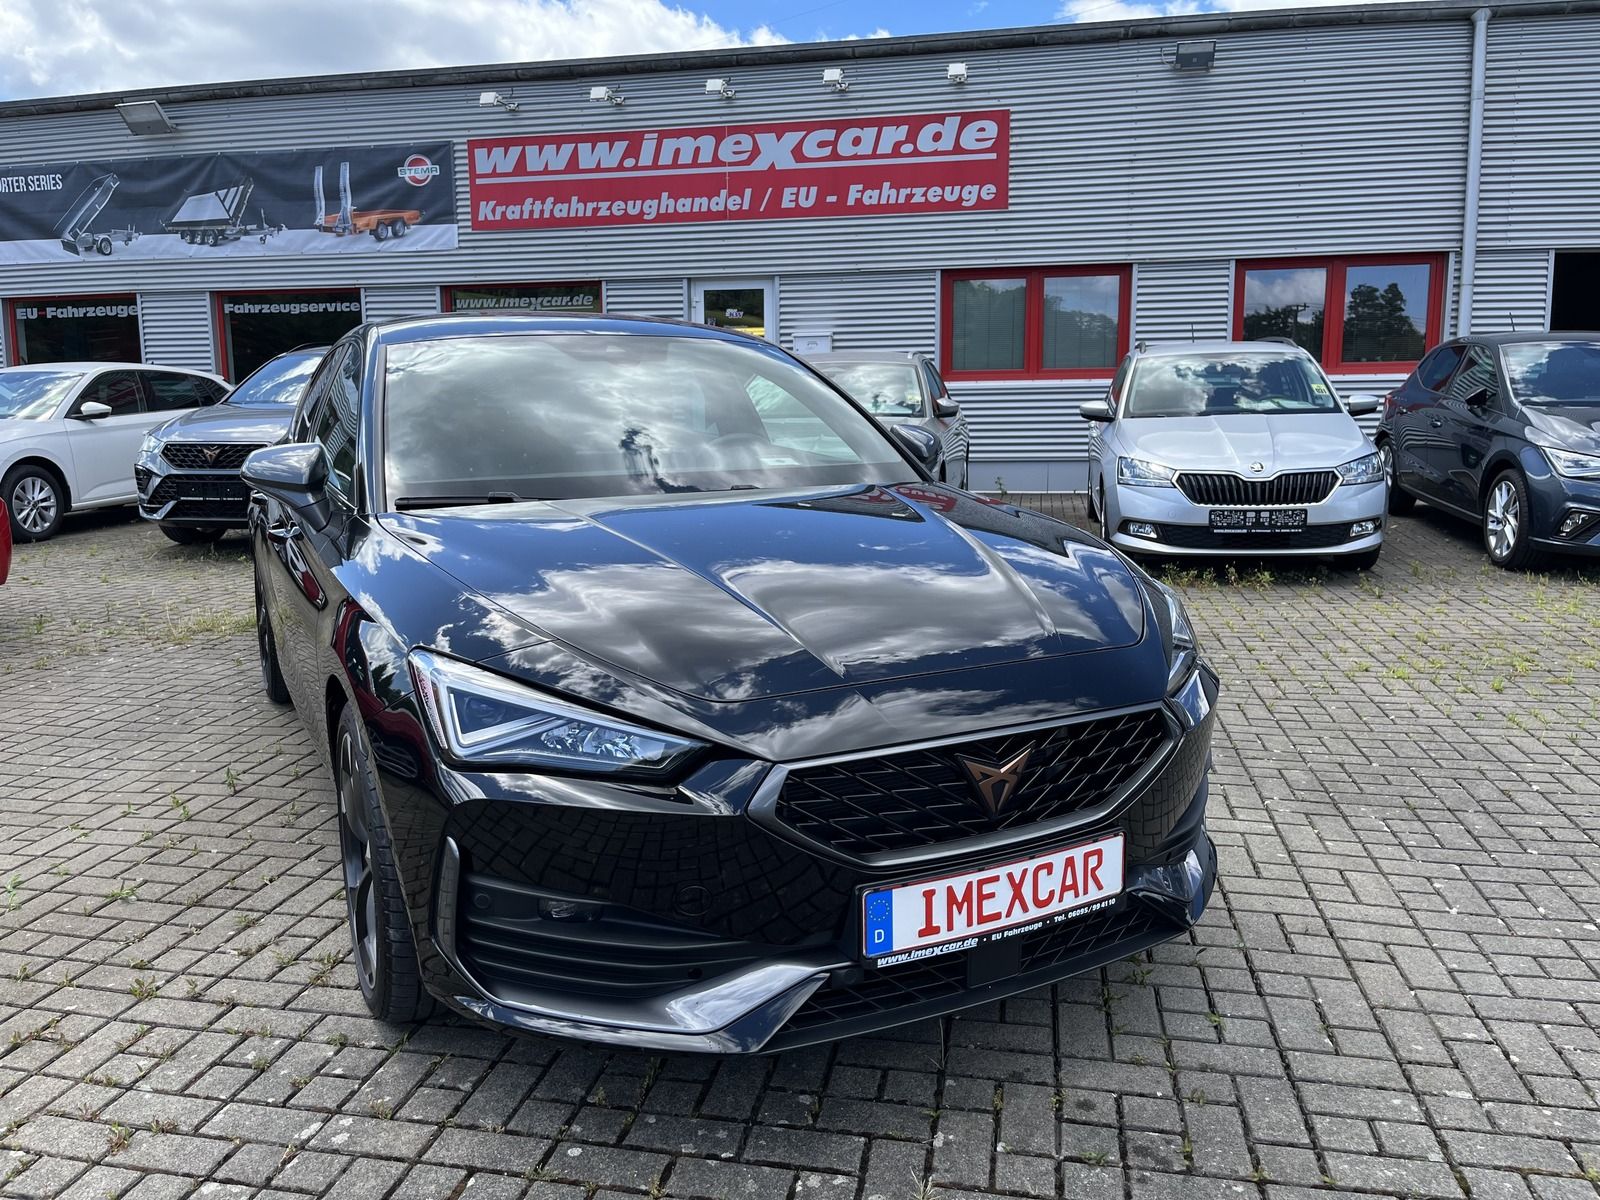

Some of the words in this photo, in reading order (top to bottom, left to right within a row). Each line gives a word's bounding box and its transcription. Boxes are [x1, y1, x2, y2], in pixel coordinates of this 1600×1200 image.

[474, 115, 999, 174] www.imexcar.de
[400, 166, 439, 176] STEMA
[0, 176, 27, 193] RTER
[28, 173, 63, 191] SERIES
[478, 187, 752, 221] Kraftfahrzeughandel
[760, 187, 772, 212] /
[781, 186, 818, 209] EU
[847, 182, 997, 207] Fahrzeuge
[223, 302, 361, 315] Fahrzeugservice
[456, 293, 594, 311] www.imexcar.de
[16, 304, 138, 320] EU-Fahrzeuge
[918, 848, 1104, 938] IMEXCAR
[874, 929, 885, 944] D
[877, 937, 979, 967] www.imexcar.de
[991, 932, 1002, 941] EU
[1003, 921, 1043, 938] Fahrzeuge
[1054, 913, 1067, 923] Tel.
